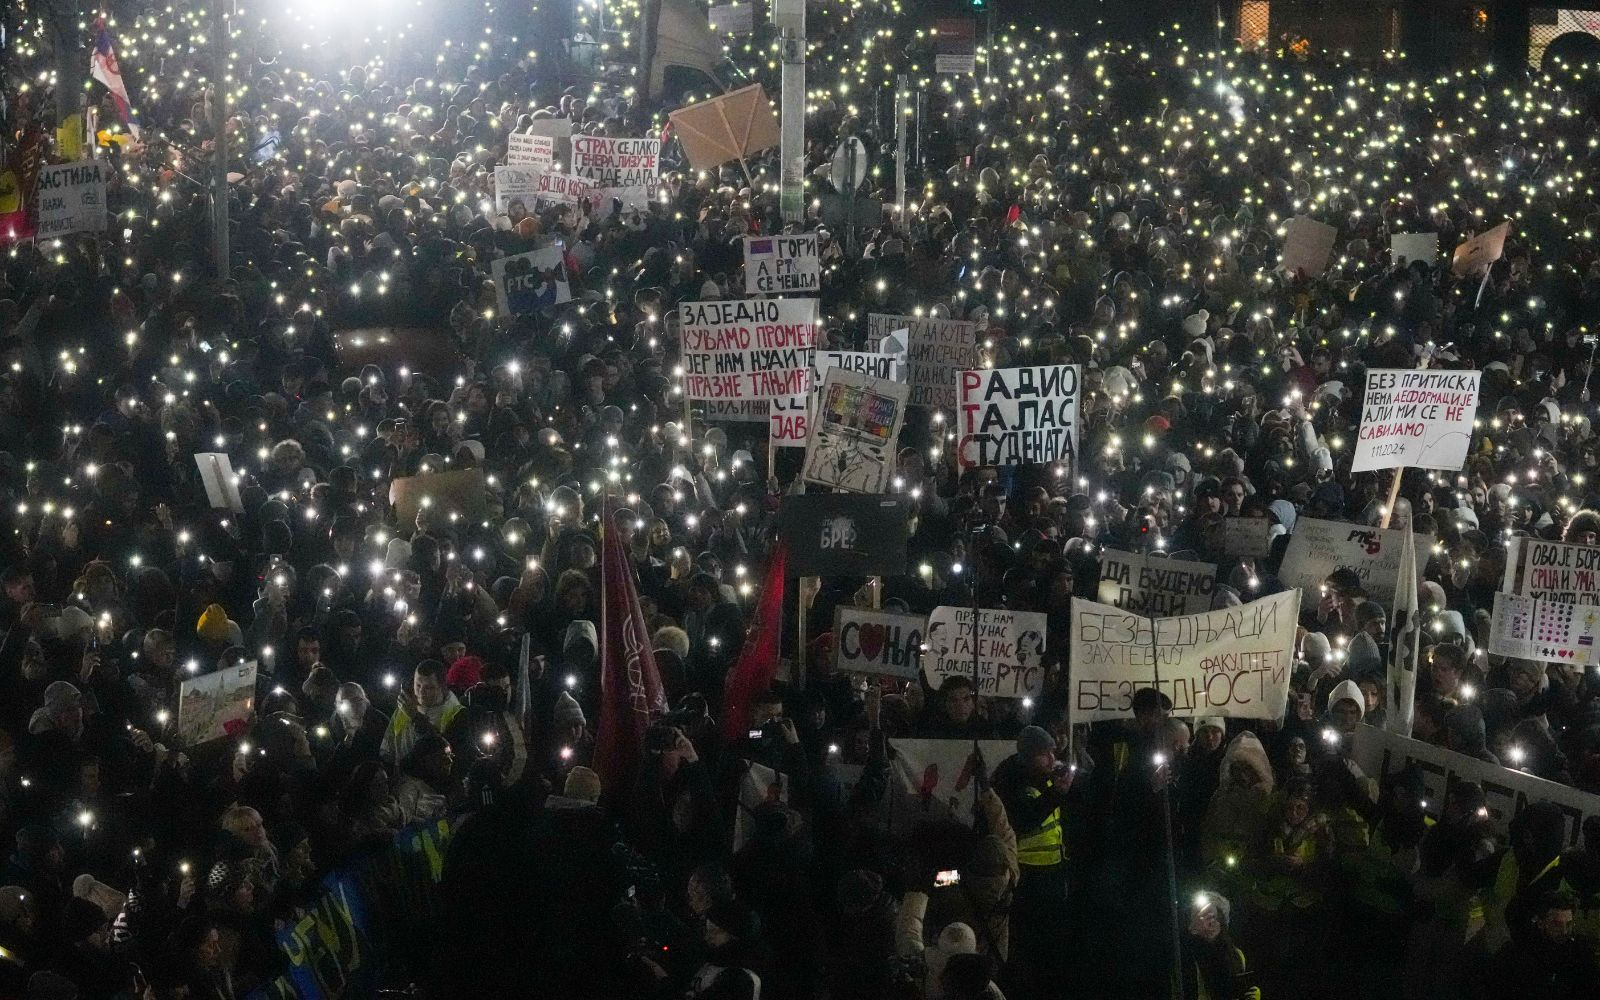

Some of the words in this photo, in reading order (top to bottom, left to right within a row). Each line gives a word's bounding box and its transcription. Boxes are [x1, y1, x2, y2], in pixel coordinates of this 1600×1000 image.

[575, 138, 616, 155] СТРАХ
[617, 141, 629, 154] СЕ
[629, 140, 659, 155] ЛАКО
[574, 152, 656, 168] ГЕНЕРАЛИЗУЈЕ
[778, 238, 816, 258] ГОРИ
[757, 260, 769, 276] А
[776, 258, 801, 275] РТС
[757, 275, 774, 291] СЕ
[776, 272, 817, 289] ЧЕШЉА
[684, 302, 779, 326] ЗАЈЕДНО
[683, 327, 750, 351] КУВАМО
[756, 323, 817, 348] ПРОМЕНЕ
[684, 353, 711, 375] ЈЕР
[714, 352, 744, 374] НАМ
[750, 346, 816, 371] НУДИТЕ
[686, 374, 742, 397] ПРАЗНЕ
[747, 368, 811, 396] ТАЊИРЕ
[962, 365, 1078, 402] РАДИО
[1367, 373, 1397, 391] БЕЗ
[1401, 373, 1476, 392] ПРИТИСКА
[1366, 391, 1392, 406] НЕМА
[1393, 389, 1474, 407] ДЕФОРМАЦИЈЕ
[962, 398, 1074, 434] ТАЛАС
[1363, 405, 1394, 423] АЛИ
[1396, 403, 1418, 420] МИ
[1420, 404, 1439, 420] СЕ
[1445, 406, 1464, 421] НЕ
[1359, 422, 1425, 440] САВИЈАМО
[958, 428, 1076, 468] СТУДЕНАТА
[1531, 543, 1558, 567] ОВО
[1558, 546, 1573, 567] ЈЕ
[1100, 560, 1130, 585] ДА
[1139, 566, 1215, 596] БУДЕМО
[1530, 568, 1560, 592] СРЦА
[1561, 570, 1571, 588] И
[1572, 570, 1597, 592] УМА
[957, 622, 987, 637] ТУУ
[988, 625, 1007, 638] НАС
[993, 613, 1014, 624] НАМ
[953, 637, 987, 658] ГАЕ
[990, 641, 1014, 659] НАС
[934, 657, 975, 674] ДОКЛЕ
[1200, 650, 1284, 674] ФАКУЛТЕТ
[995, 662, 1040, 694] РТС
[1077, 667, 1286, 716] БЕЗДНОСТИ
